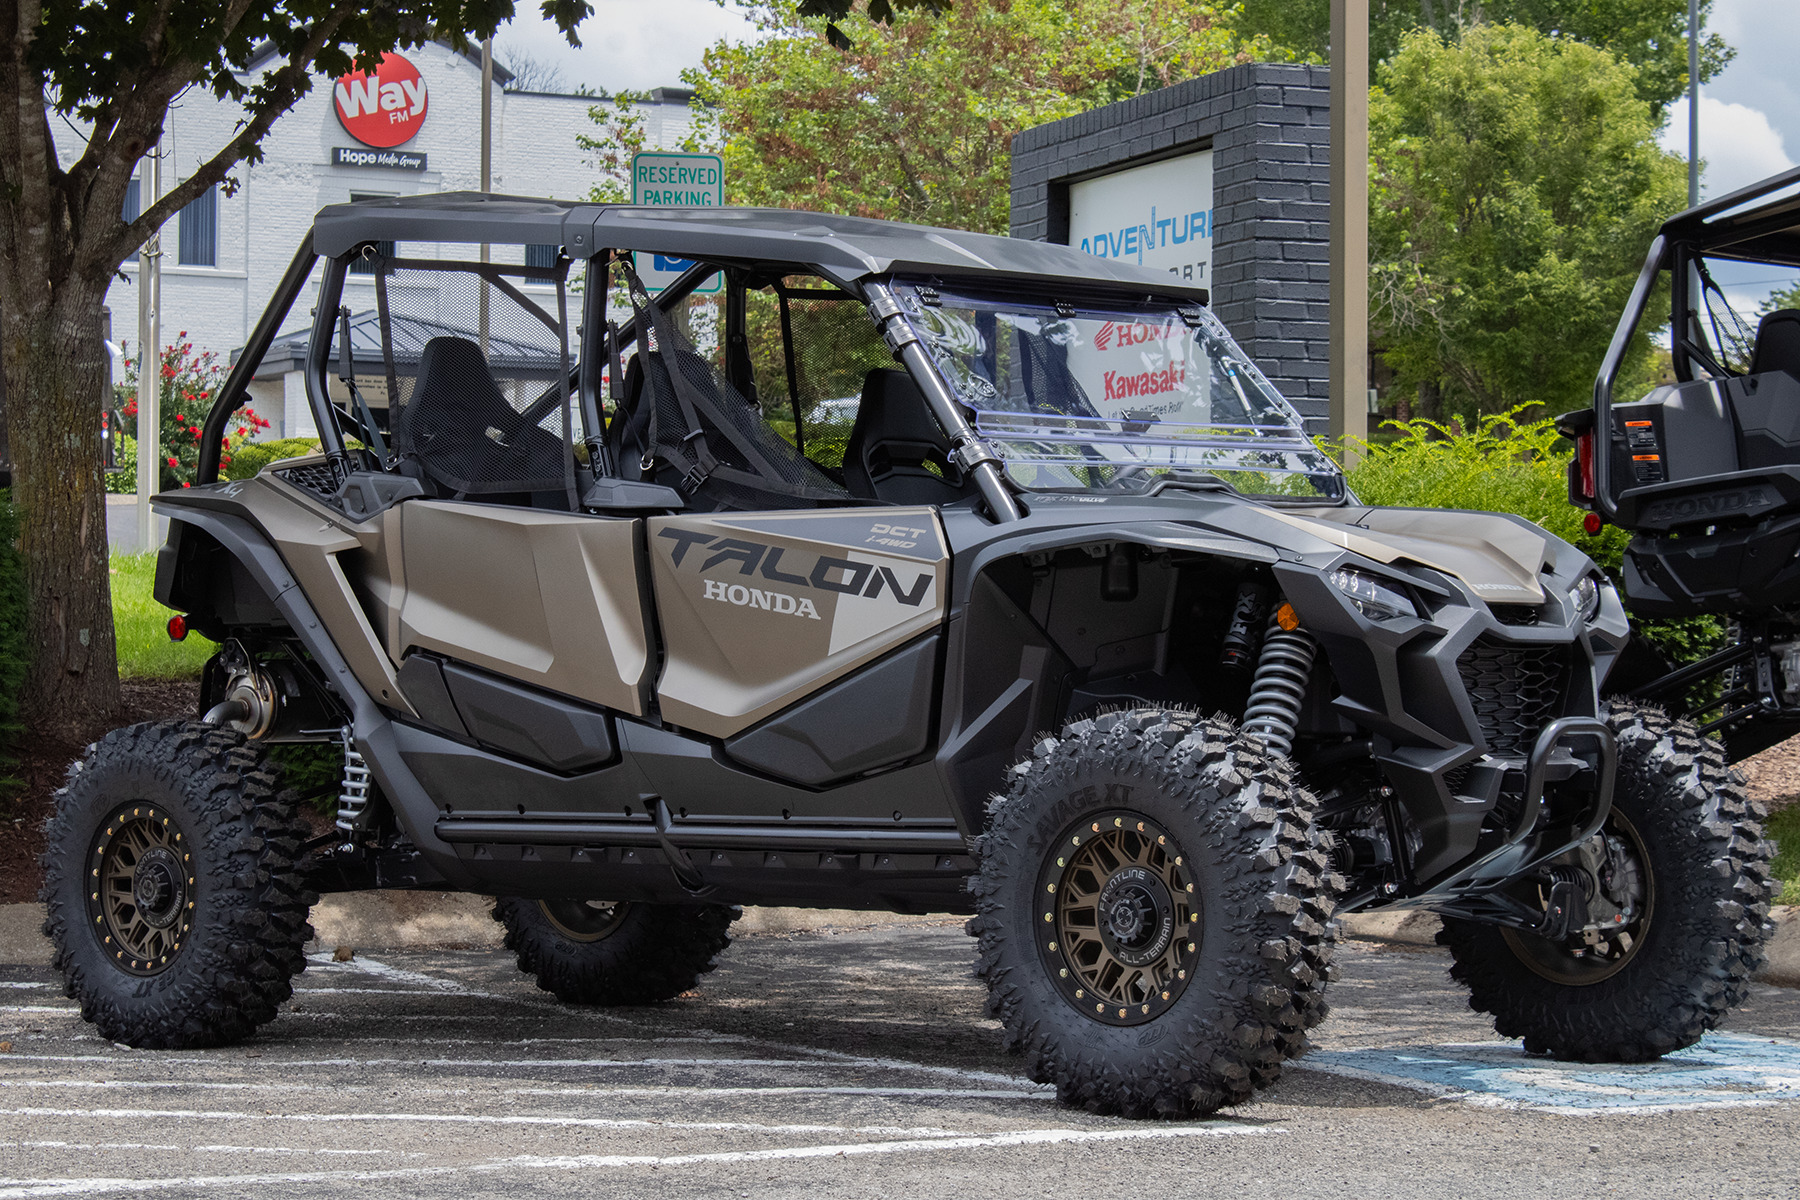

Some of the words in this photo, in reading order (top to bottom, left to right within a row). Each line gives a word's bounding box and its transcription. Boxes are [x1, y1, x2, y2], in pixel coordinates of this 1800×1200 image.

[336, 75, 426, 118] Way
[389, 110, 409, 124] FM
[340, 149, 377, 165] Hope
[378, 153, 399, 166] Media
[399, 155, 421, 168] Group
[638, 166, 717, 185] RESERVED
[644, 190, 711, 206] PARKING
[1103, 360, 1185, 401] Kawasaki
[869, 523, 927, 539] DCT
[657, 527, 934, 607] TALON
[703, 579, 821, 620] HONDA
[1027, 784, 1101, 856] SAVAGE
[1104, 782, 1134, 805] XT
[1119, 917, 1170, 964] ALL-TERRAIN
